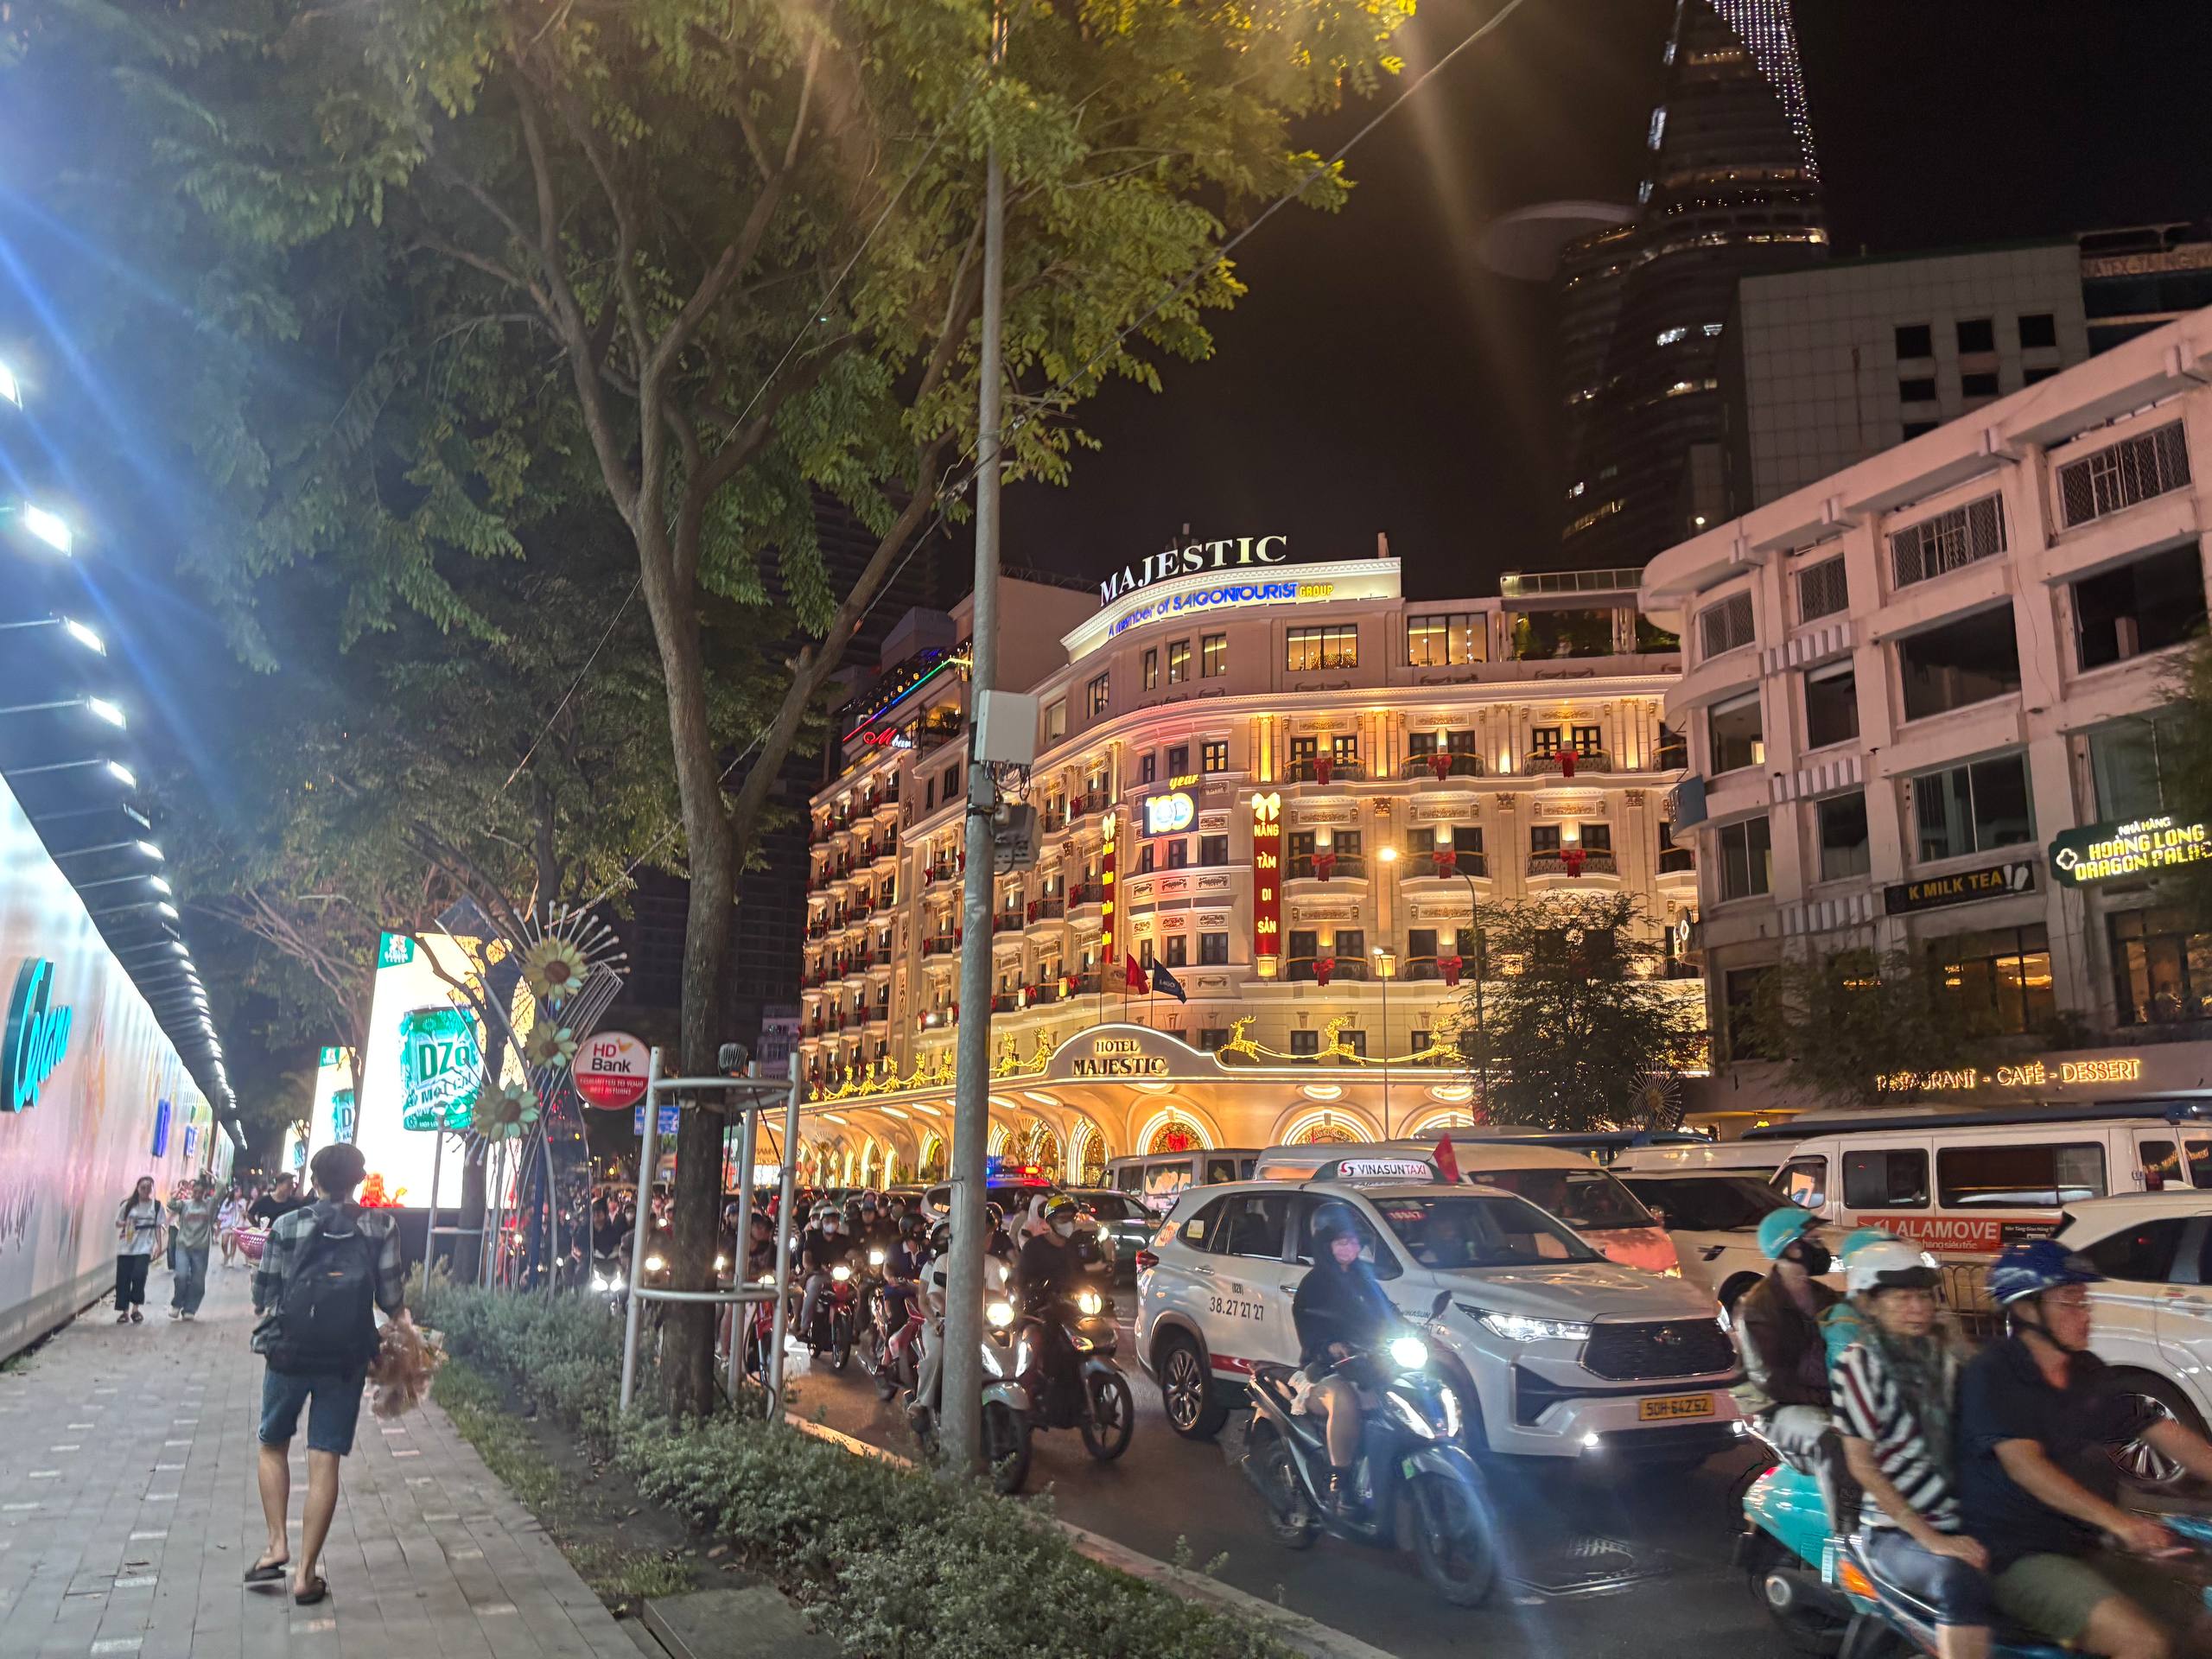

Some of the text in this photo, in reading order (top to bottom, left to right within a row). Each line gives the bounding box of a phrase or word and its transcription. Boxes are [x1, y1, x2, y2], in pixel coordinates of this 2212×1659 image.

[1100, 535, 1287, 607] MAJESTIC
[1108, 582, 1334, 638] A member of SAIGONTOURIST GROUP
[1169, 773, 1199, 791] year
[1145, 792, 1194, 834] 100
[2153, 823, 2205, 851] LONG
[2075, 853, 2149, 881] DRAGON
[1262, 887, 1272, 901] DI
[1909, 870, 2003, 900] K MILK TEA
[593, 1043, 617, 1058] HD
[1096, 1040, 1141, 1052] HOTEL
[591, 1057, 632, 1073] Bank
[1073, 1058, 1168, 1076] MAJESTIC
[1996, 1061, 2046, 1086] CAFÉ
[2061, 1058, 2140, 1084] DESSERT
[1240, 1300, 1251, 1319] 27
[1253, 1303, 1264, 1321] 27
